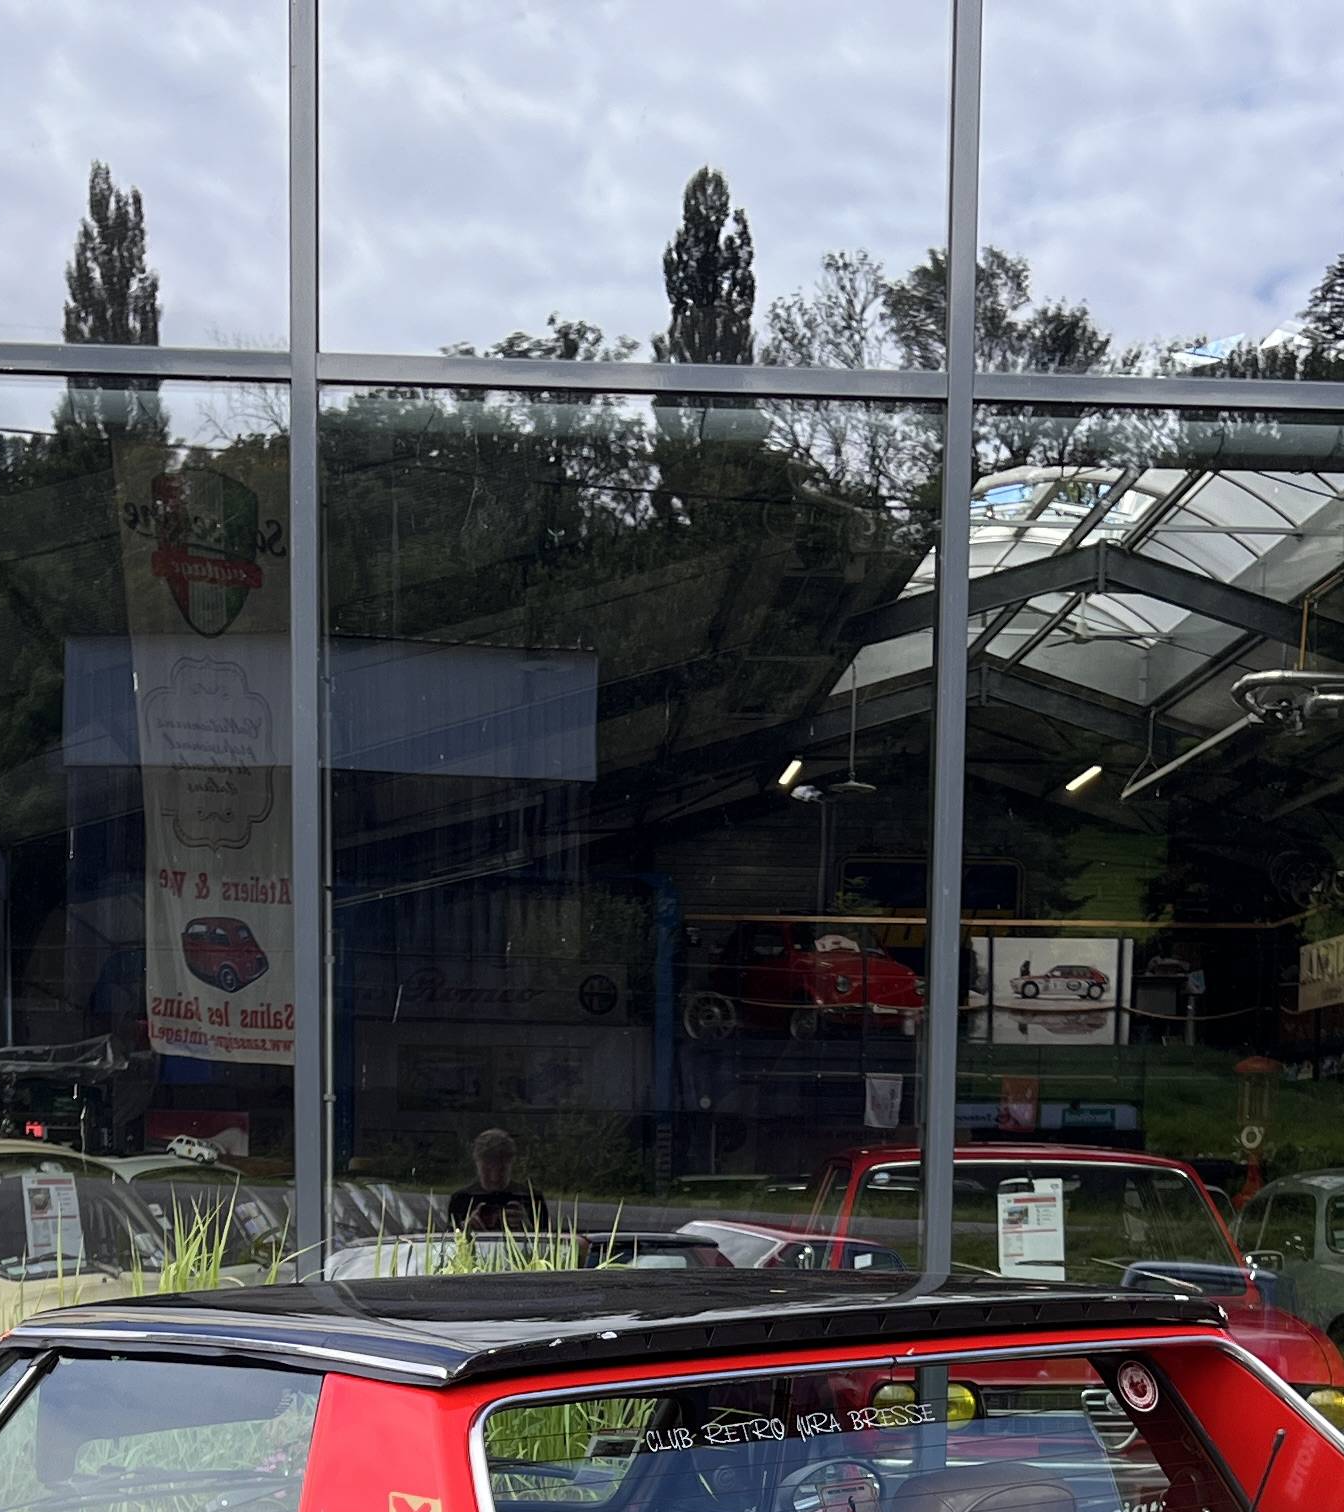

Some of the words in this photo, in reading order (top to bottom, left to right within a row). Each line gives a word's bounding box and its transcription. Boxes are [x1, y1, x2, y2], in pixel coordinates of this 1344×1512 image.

[646, 1426, 697, 1453] CLUB
[700, 1416, 786, 1445] RETRO
[796, 1411, 843, 1443] JURA
[846, 1403, 936, 1431] BRESSE
